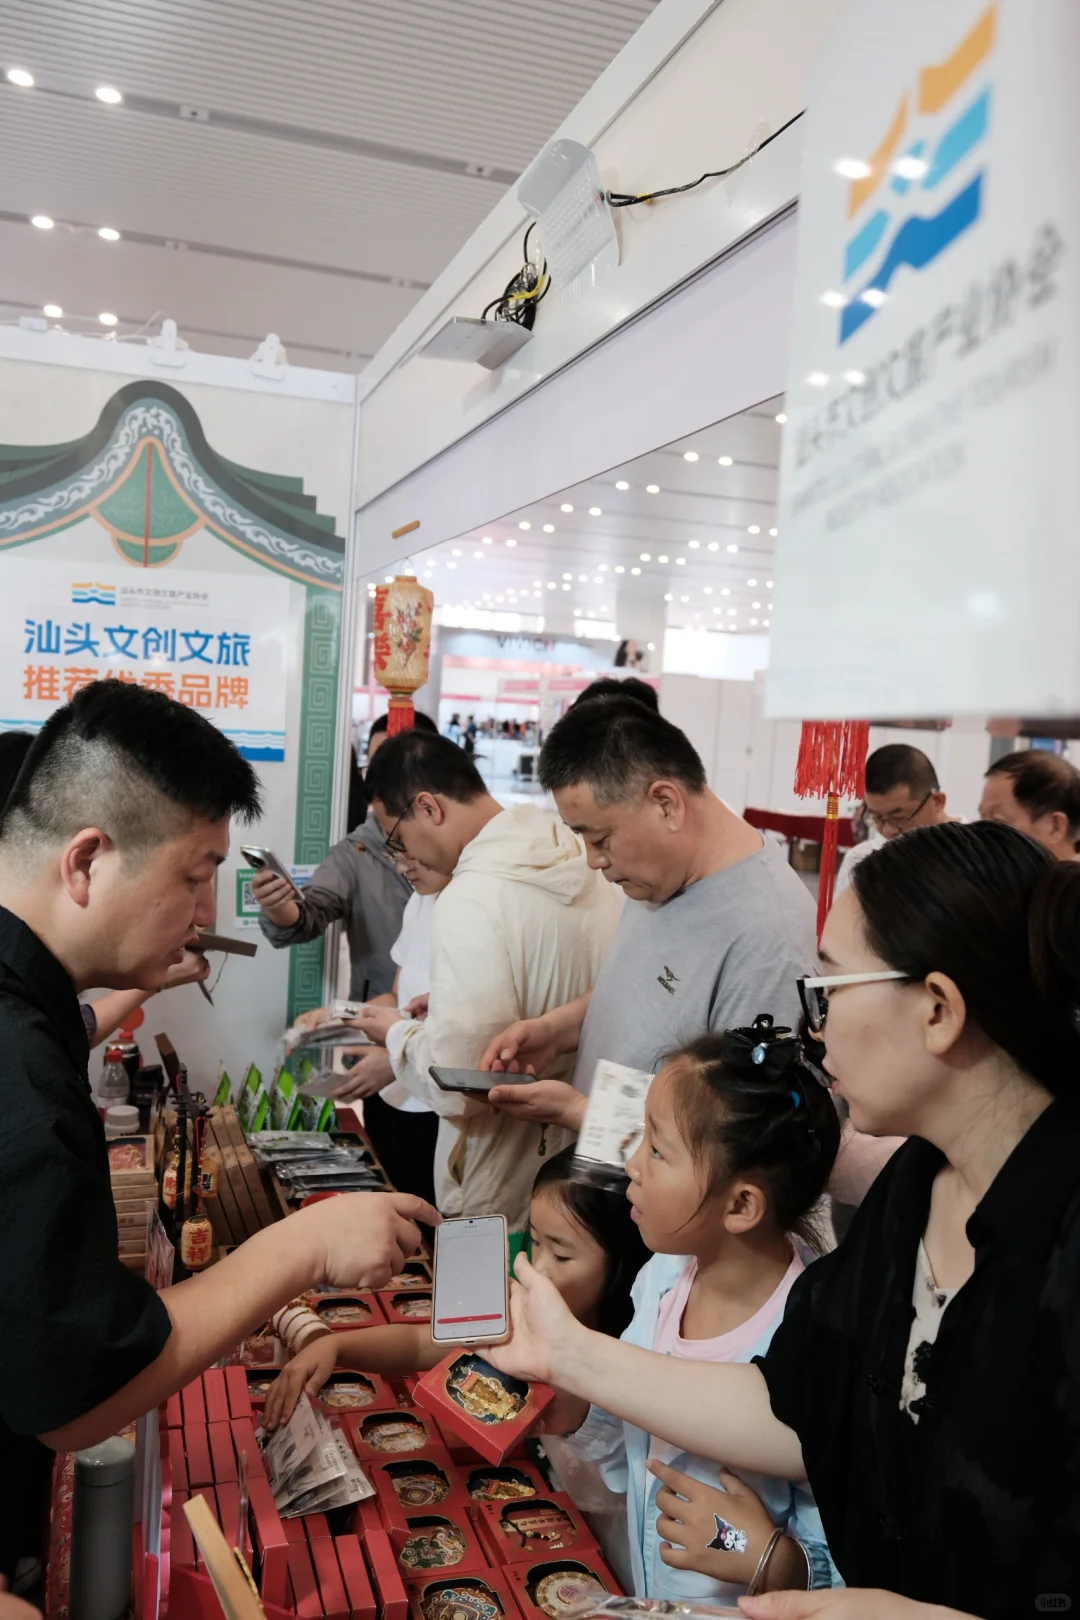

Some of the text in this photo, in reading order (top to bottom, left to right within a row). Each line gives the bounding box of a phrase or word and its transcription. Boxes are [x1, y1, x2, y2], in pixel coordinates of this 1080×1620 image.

[24, 619, 250, 666] 汕头文创文旅
[186, 1228, 209, 1261] 吉祥
